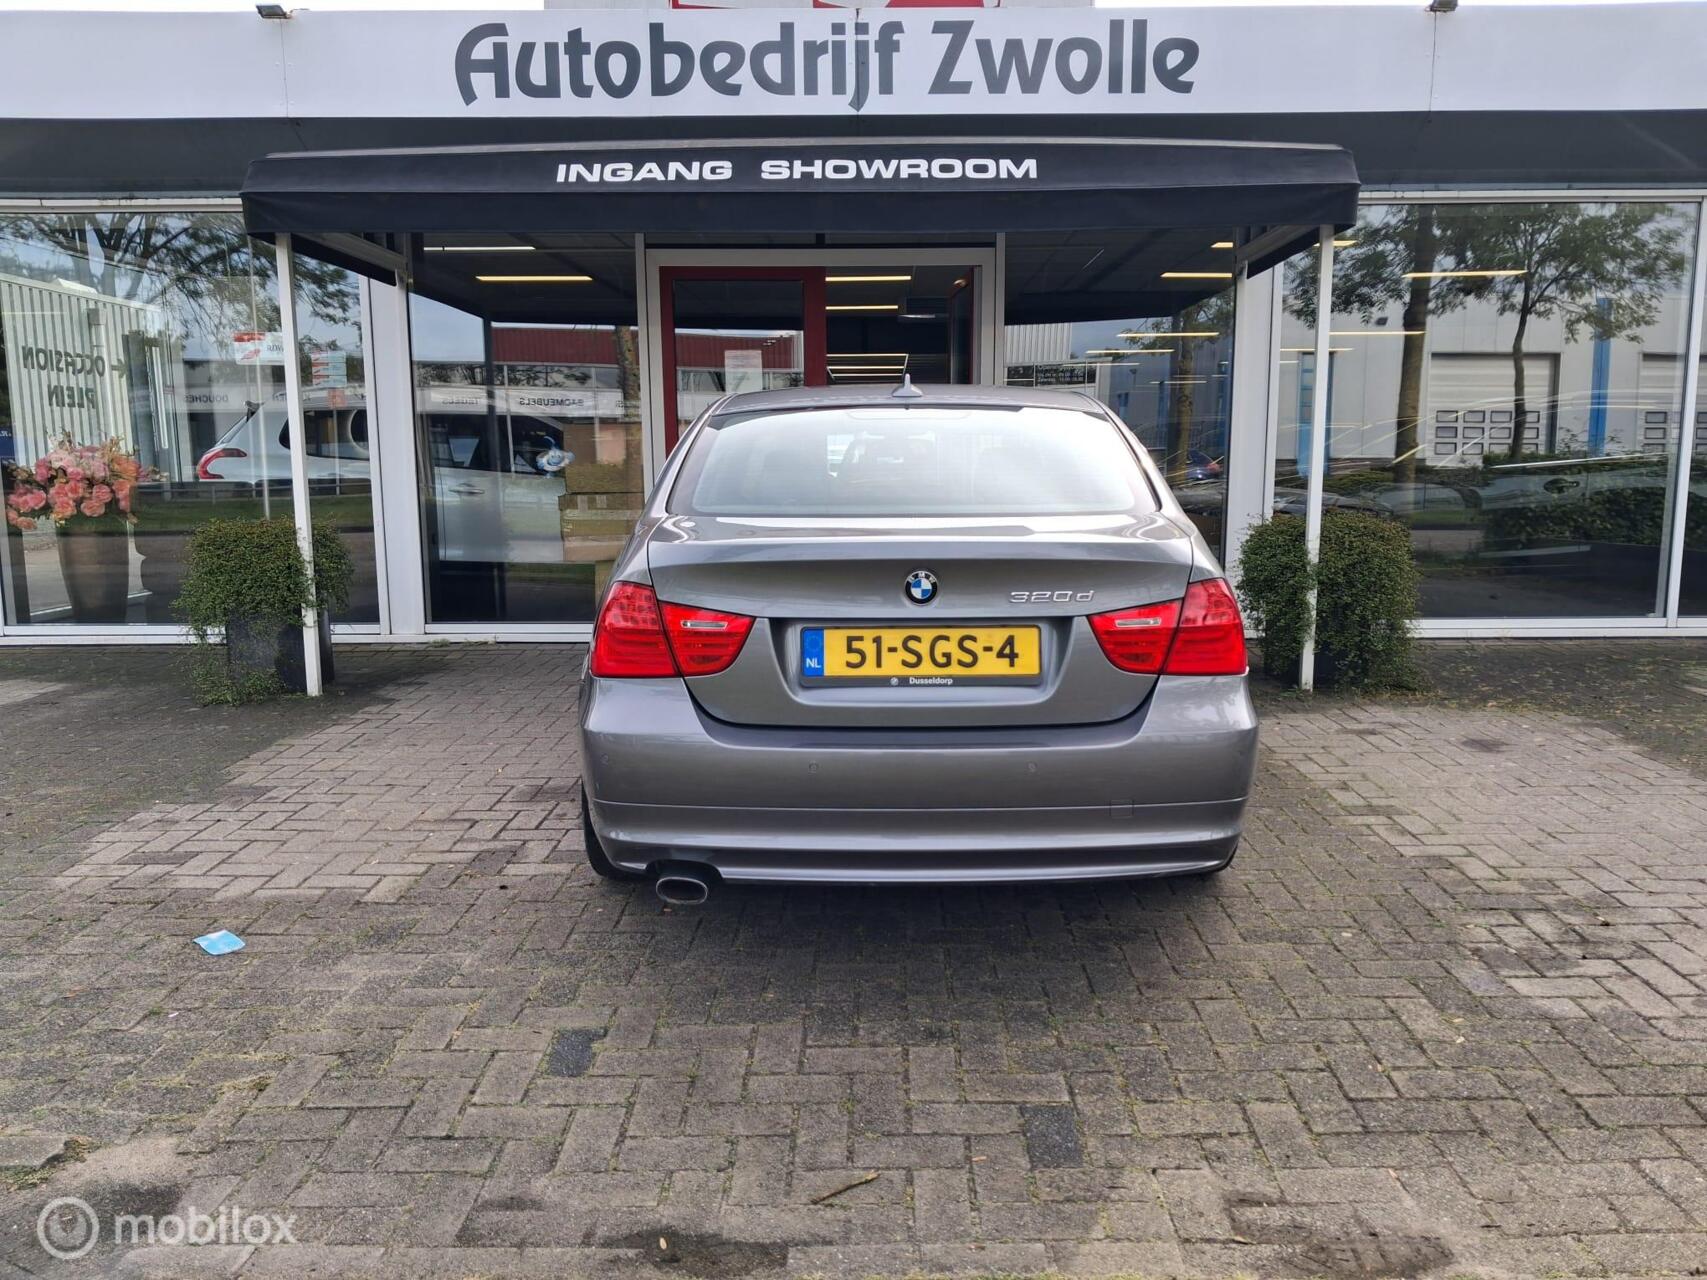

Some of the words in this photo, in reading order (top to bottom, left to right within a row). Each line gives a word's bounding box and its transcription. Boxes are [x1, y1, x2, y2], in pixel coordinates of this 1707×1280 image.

[455, 20, 904, 112] Autobedrijf
[927, 18, 1200, 95] Zwolle
[555, 159, 734, 184] INGANG
[760, 157, 1038, 181] SHOWROOM
[1010, 590, 1095, 603] 320d
[845, 634, 1019, 669] 51-SGS-4
[805, 658, 822, 668] NL
[909, 677, 953, 686] Dusseldorp
